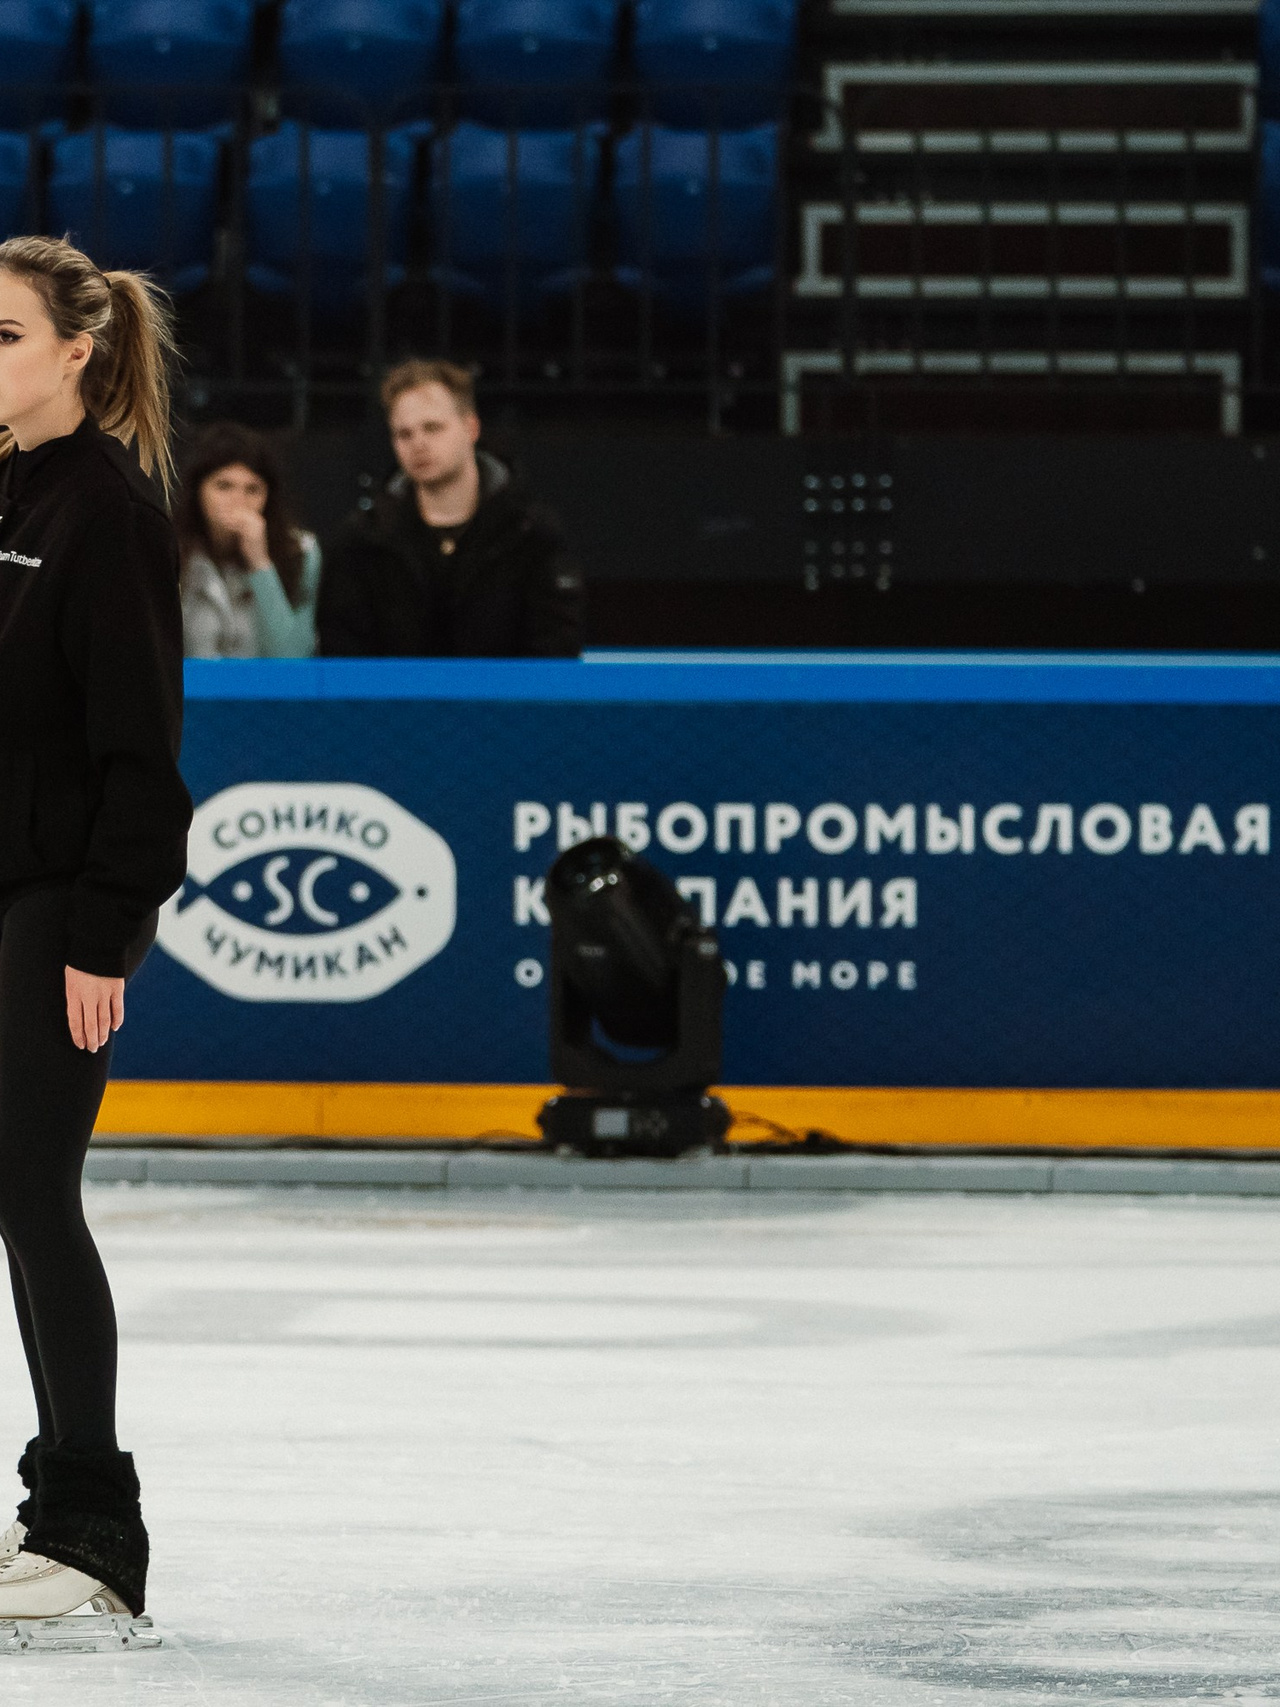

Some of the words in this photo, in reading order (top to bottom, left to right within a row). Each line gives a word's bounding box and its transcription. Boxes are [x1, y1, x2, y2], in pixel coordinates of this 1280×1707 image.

[212, 803, 390, 850] СОНИКО
[513, 801, 1273, 855] РЫБОПРОМЫСЛОВАЯ
[262, 855, 340, 927] SC
[513, 875, 918, 928] КПАНИЯ
[204, 924, 410, 980] ЧУМИКАН
[790, 960, 918, 990] МОРЕ
